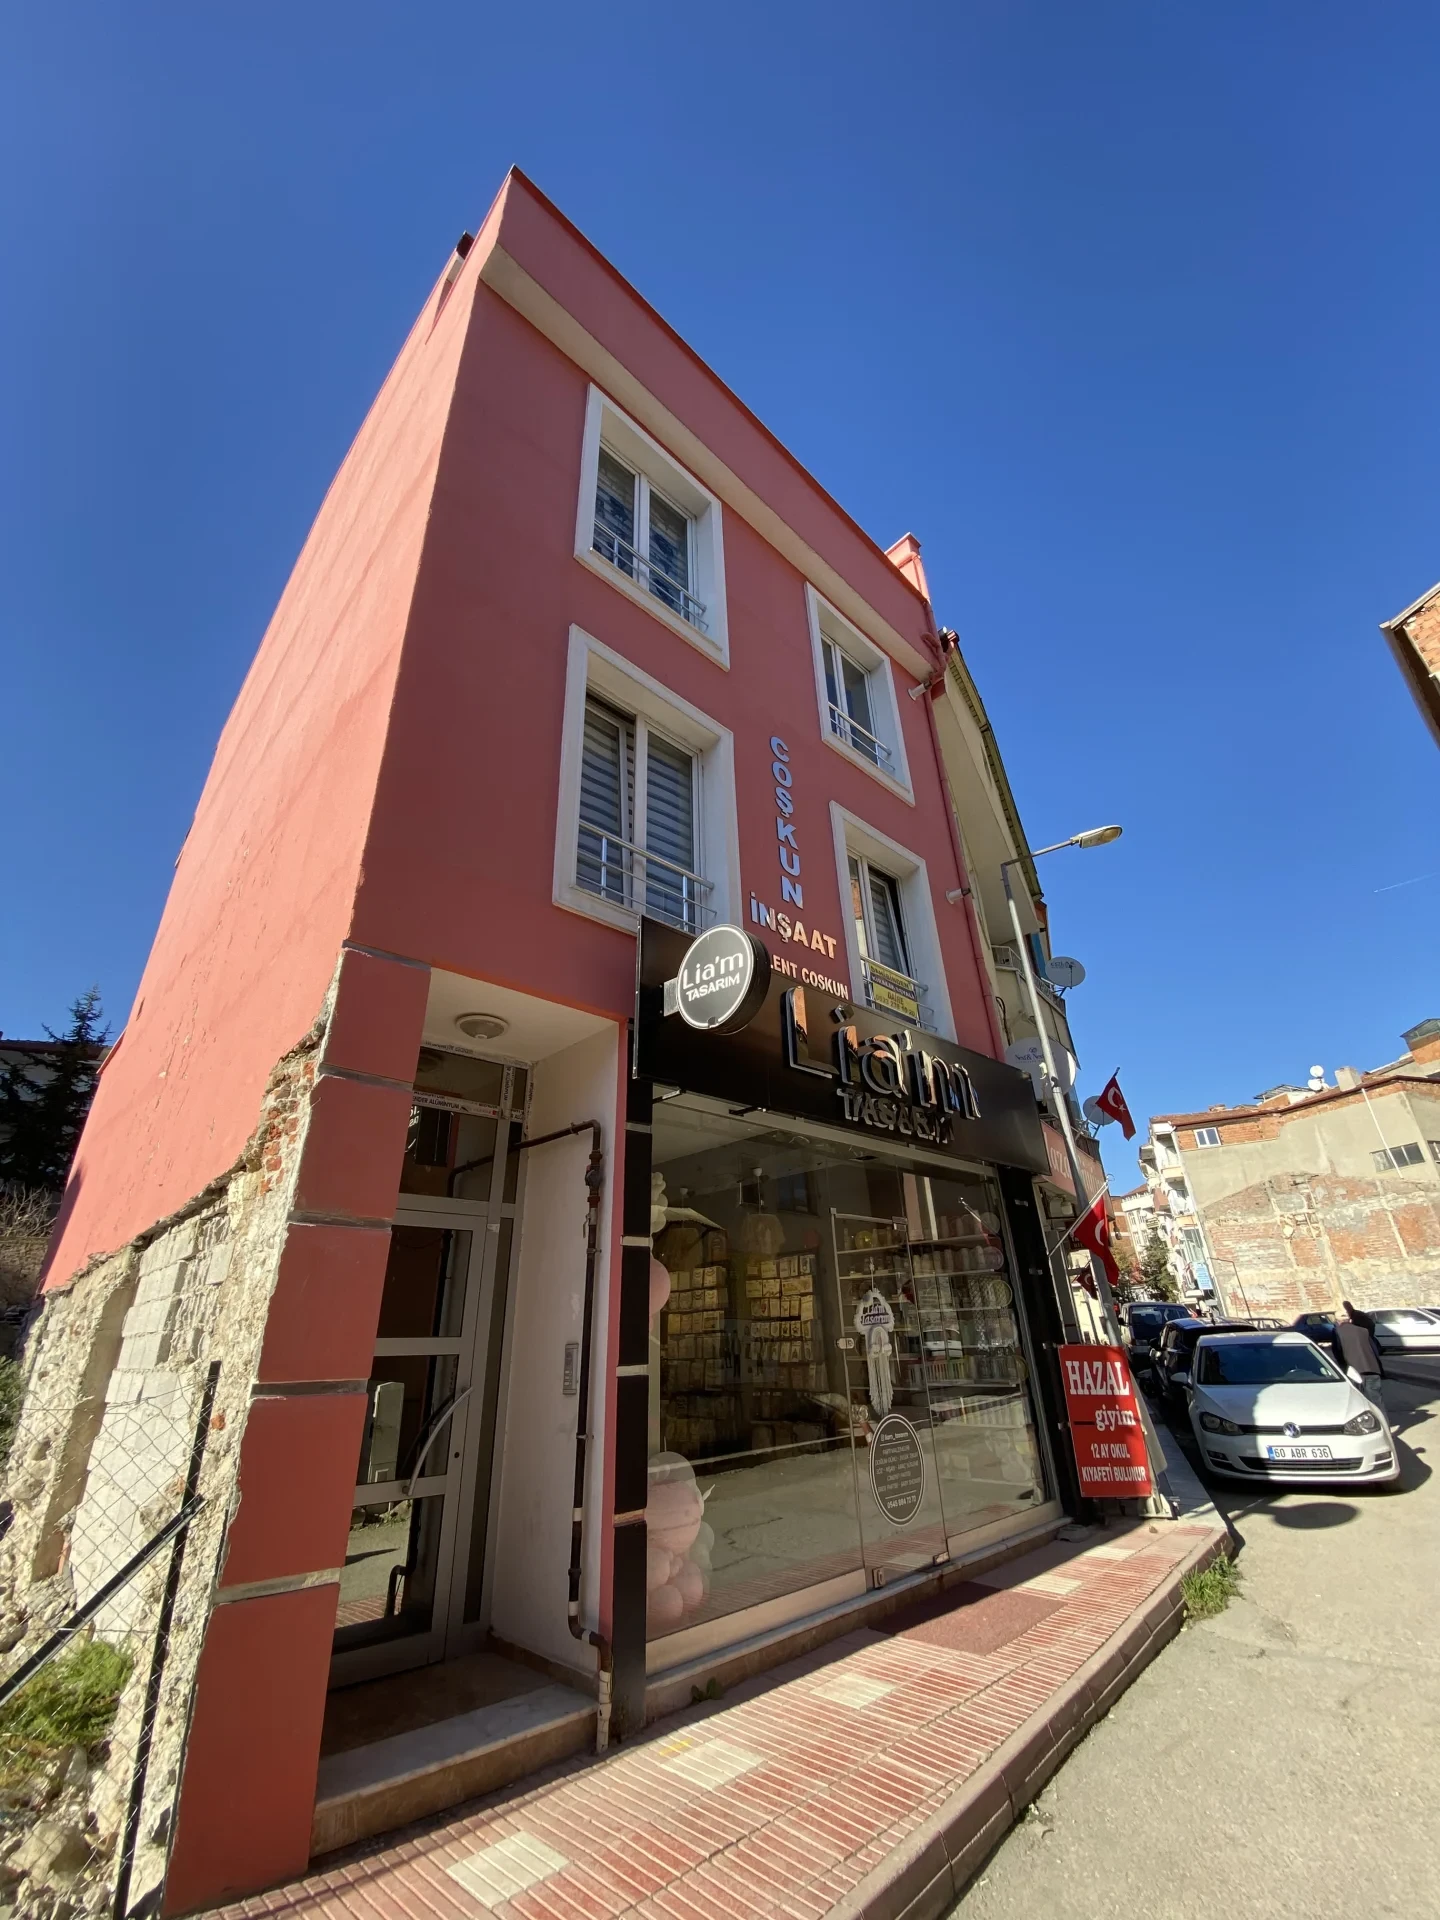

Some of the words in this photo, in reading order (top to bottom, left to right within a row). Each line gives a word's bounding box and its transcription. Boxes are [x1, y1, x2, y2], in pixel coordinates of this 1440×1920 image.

[769, 736, 804, 909] COŞKUN
[750, 891, 837, 960] İNŞAAT
[771, 954, 798, 979] ENT
[686, 972, 741, 1002] TASARIM
[1066, 1361, 1130, 1395] HAZAL
[1095, 1404, 1136, 1431] giyim
[1091, 1443, 1100, 1459] 12
[1101, 1443, 1110, 1459] AY
[1110, 1443, 1130, 1459] OKUL
[1274, 1448, 1286, 1458] 60
[1290, 1448, 1307, 1458] ABR
[1312, 1448, 1329, 1458] 636
[1081, 1463, 1113, 1482] KIYAFETİ
[1113, 1466, 1147, 1481] BULUNUR
